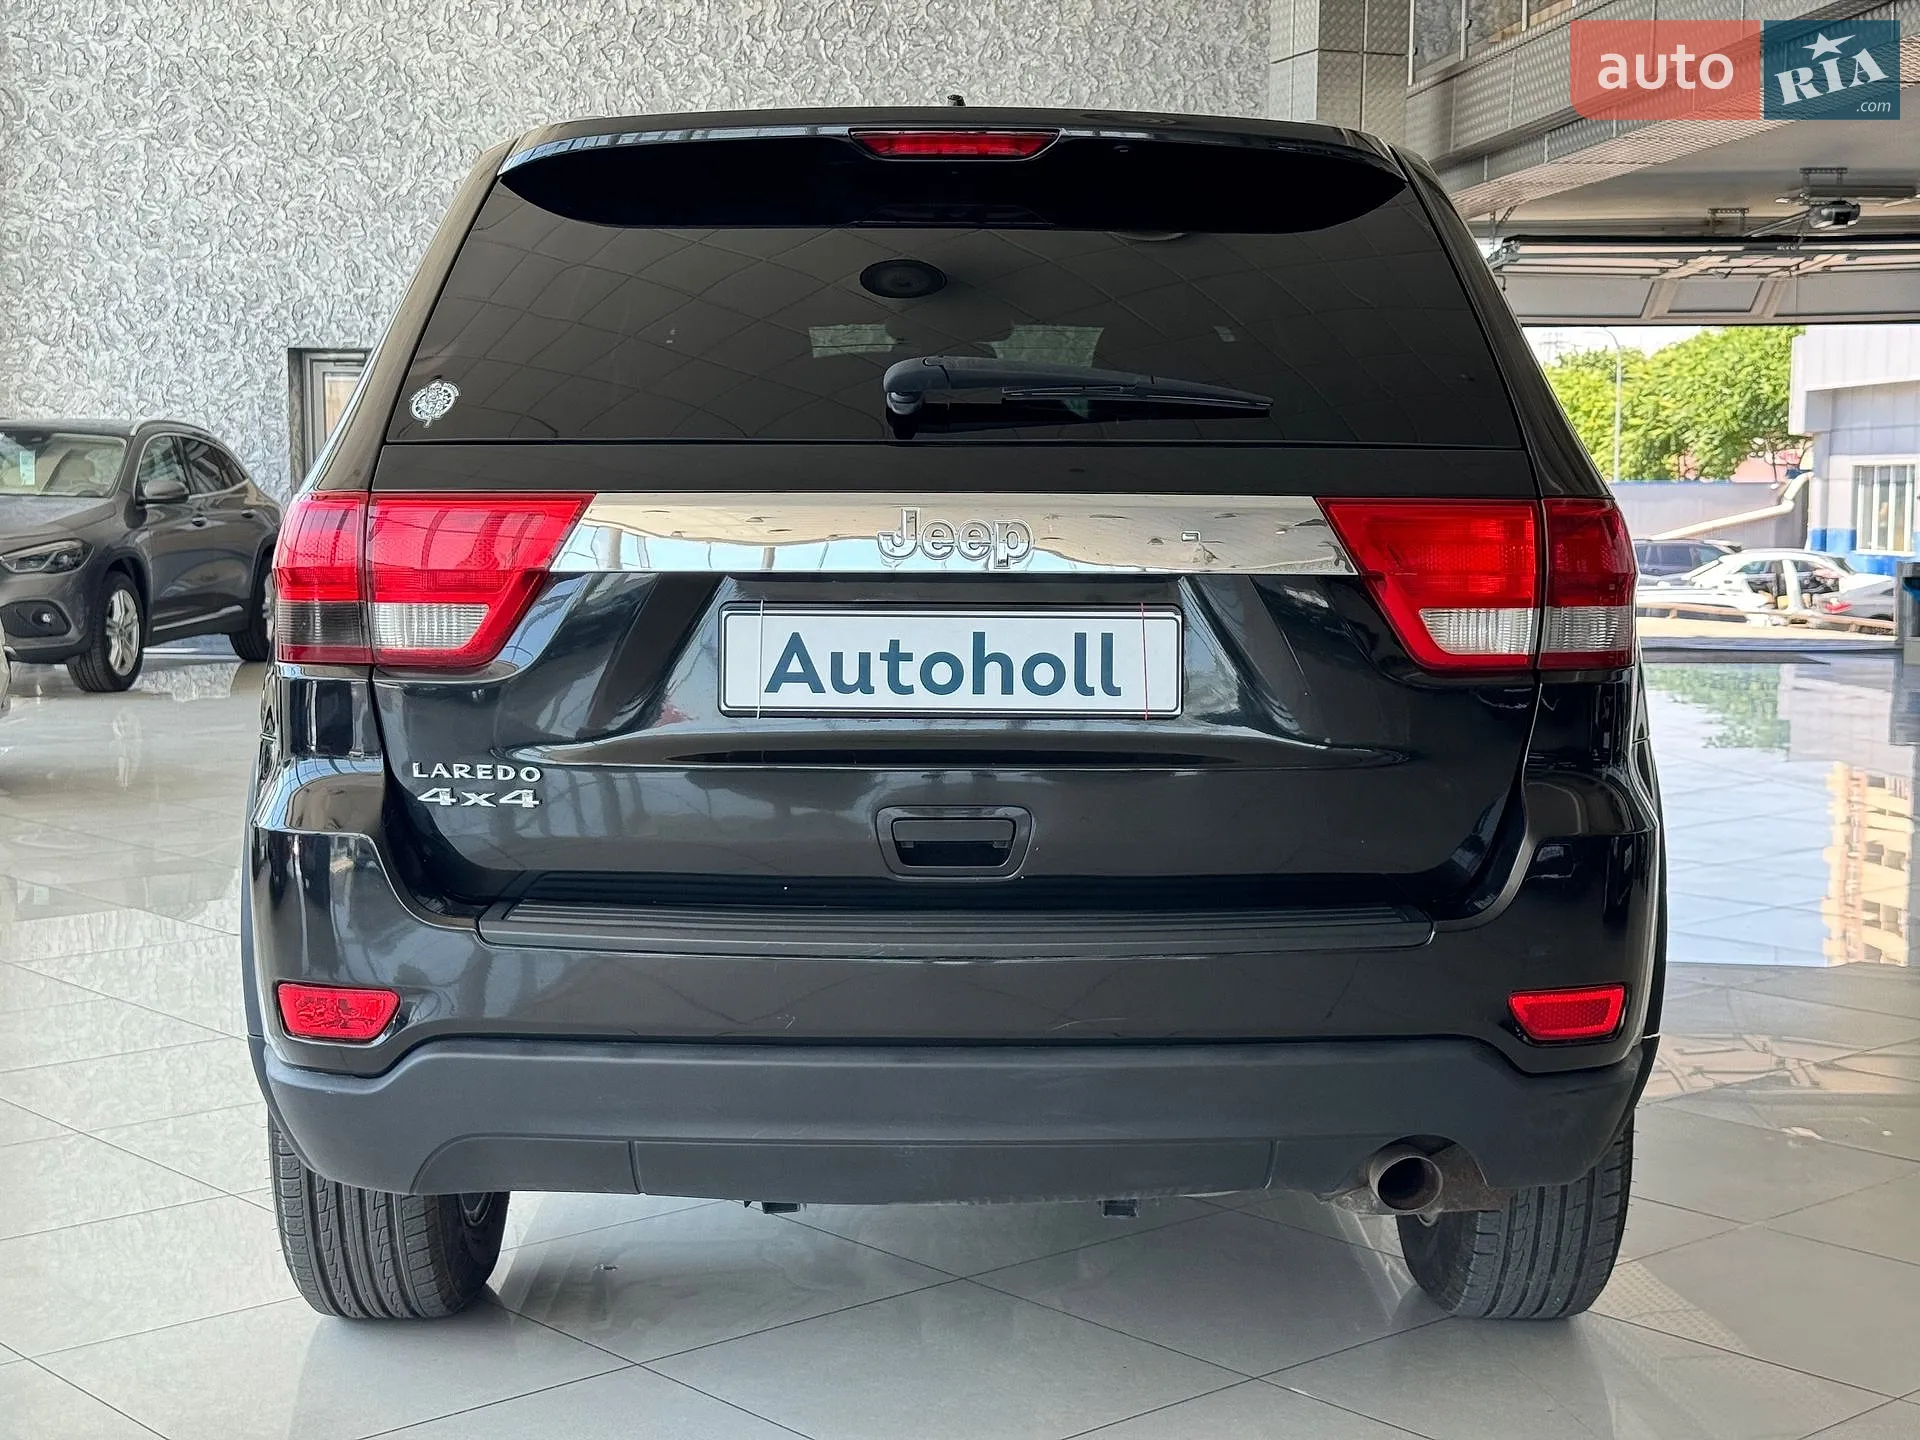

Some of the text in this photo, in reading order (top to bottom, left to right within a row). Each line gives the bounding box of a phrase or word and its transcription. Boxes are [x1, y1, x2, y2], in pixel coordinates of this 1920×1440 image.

[877, 506, 1033, 569] Jeep
[764, 631, 1122, 696] Autoholl
[412, 762, 541, 782] LAREDO
[417, 787, 541, 808] 4x4
